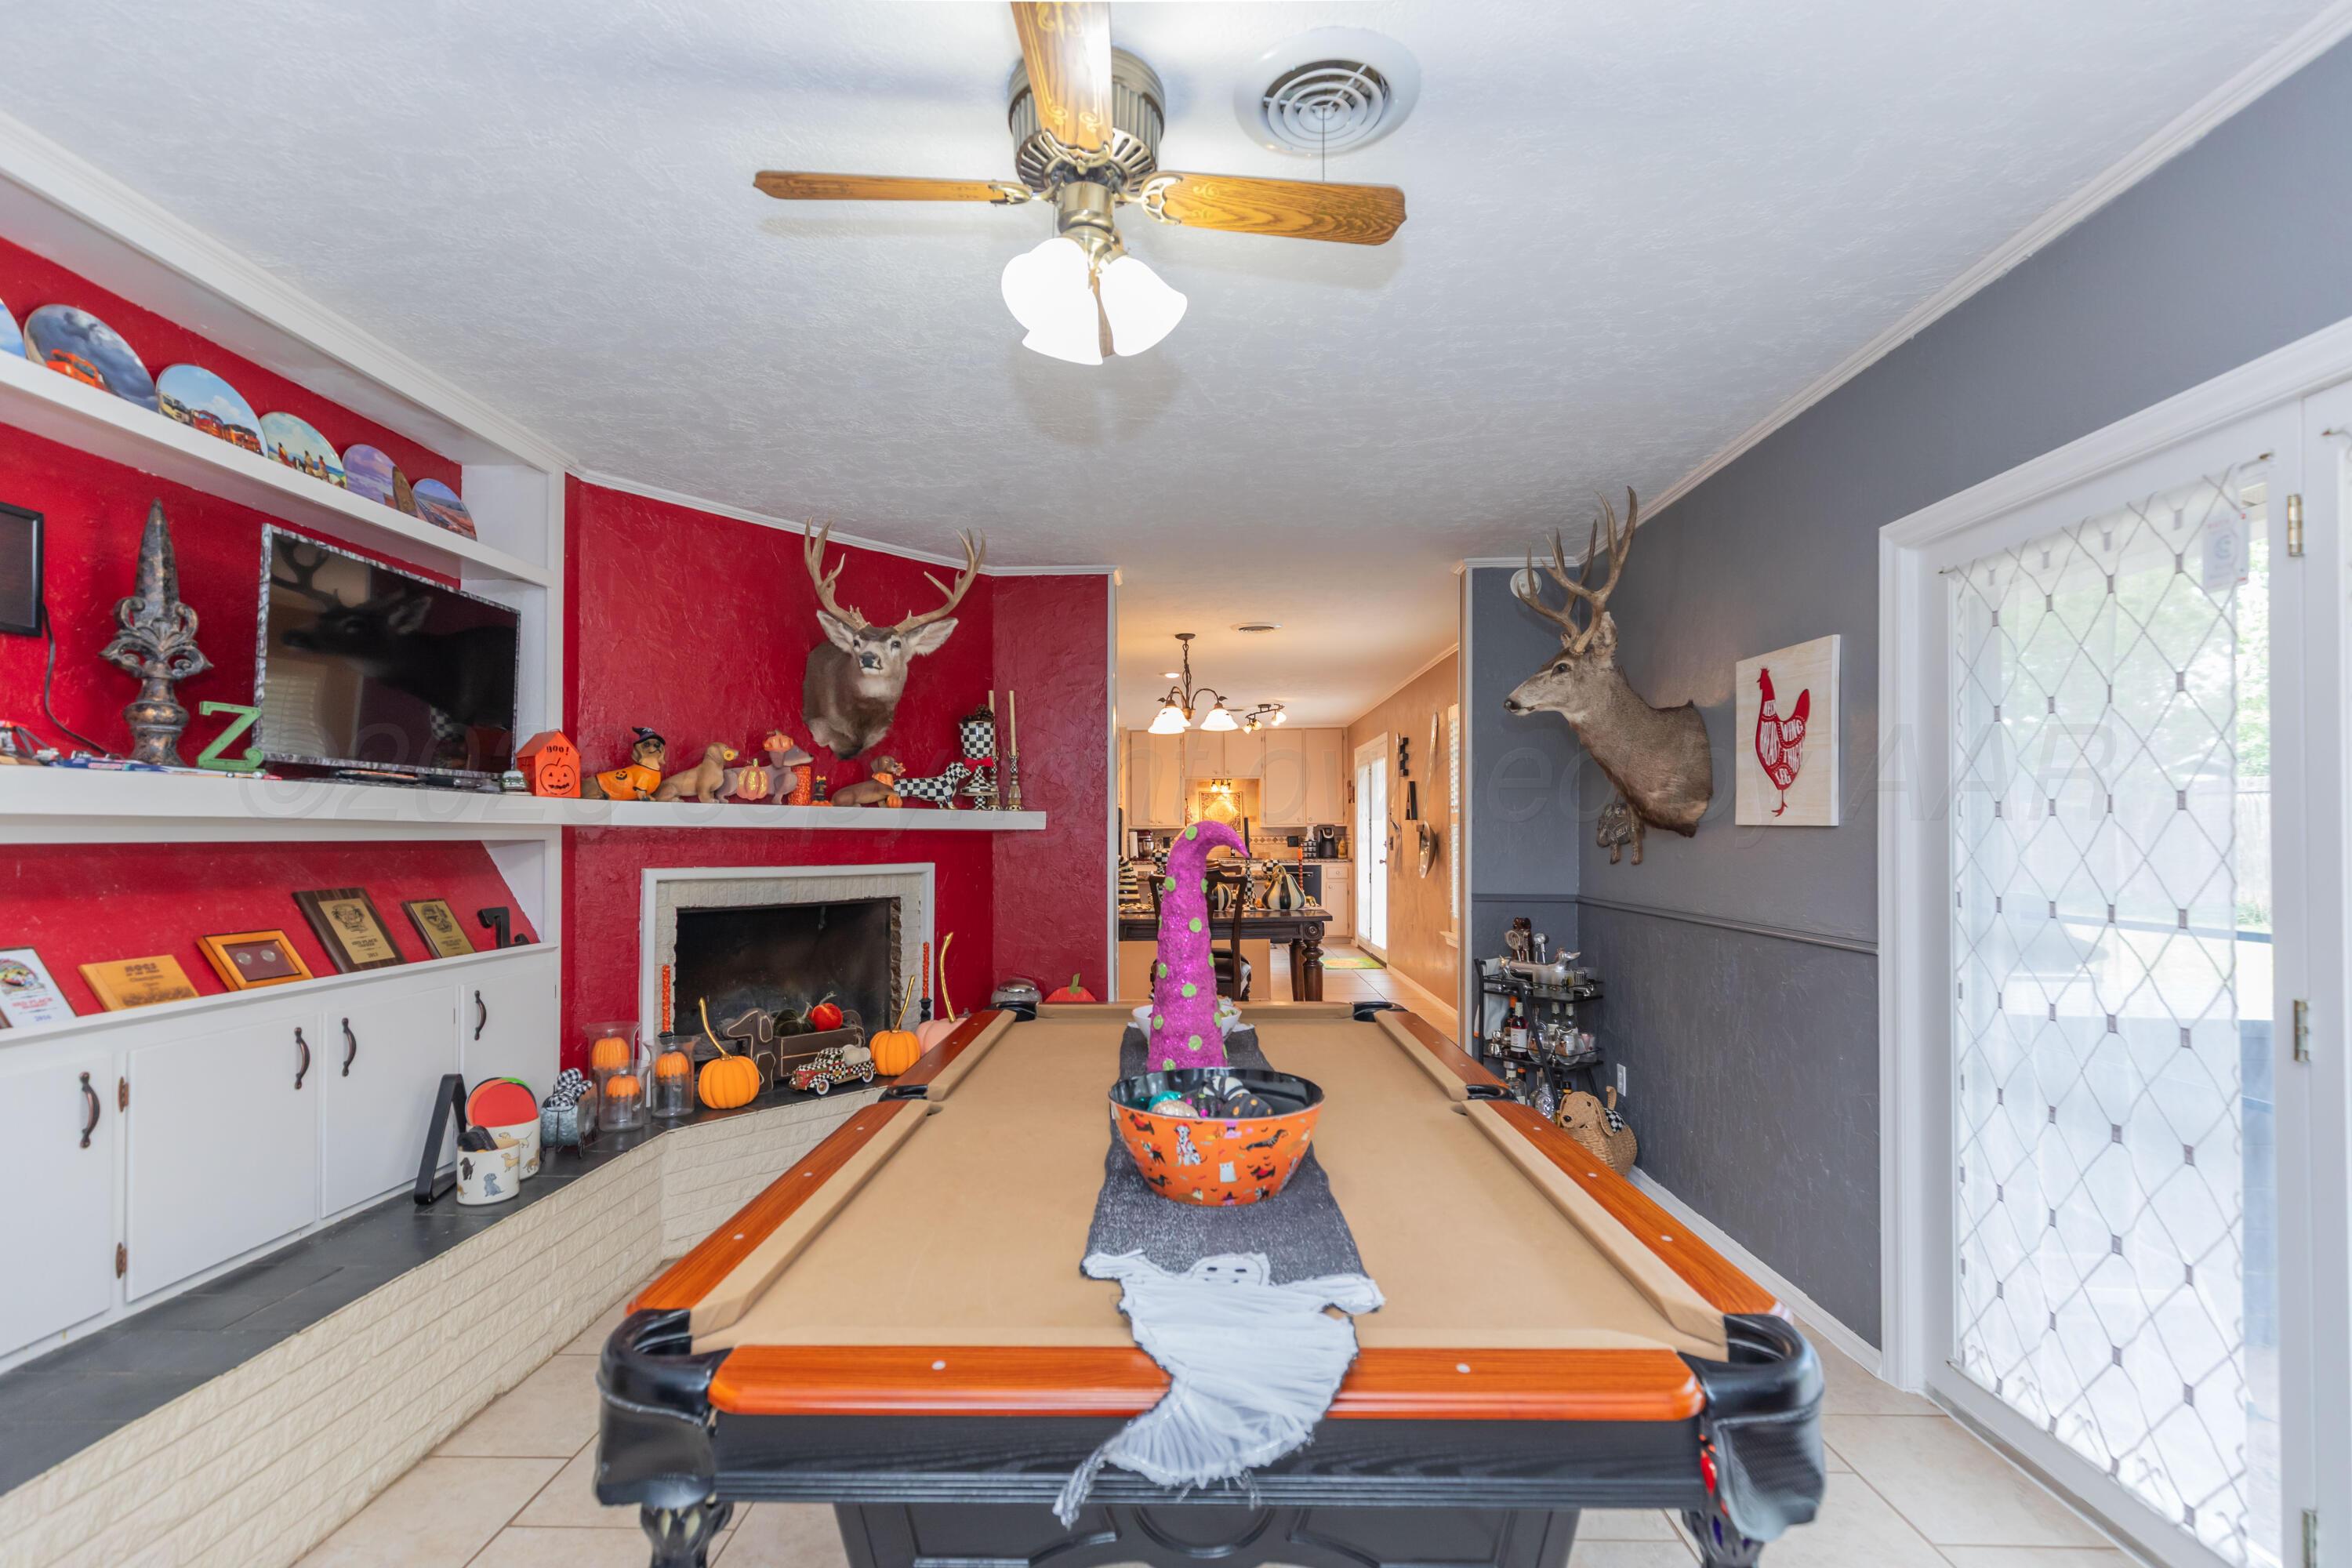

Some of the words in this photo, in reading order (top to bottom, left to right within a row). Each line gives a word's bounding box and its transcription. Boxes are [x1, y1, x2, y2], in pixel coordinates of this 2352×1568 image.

[1781, 719, 1804, 742] WING
[546, 745, 570, 756] BOO!
[1774, 768, 1792, 786] LEG
